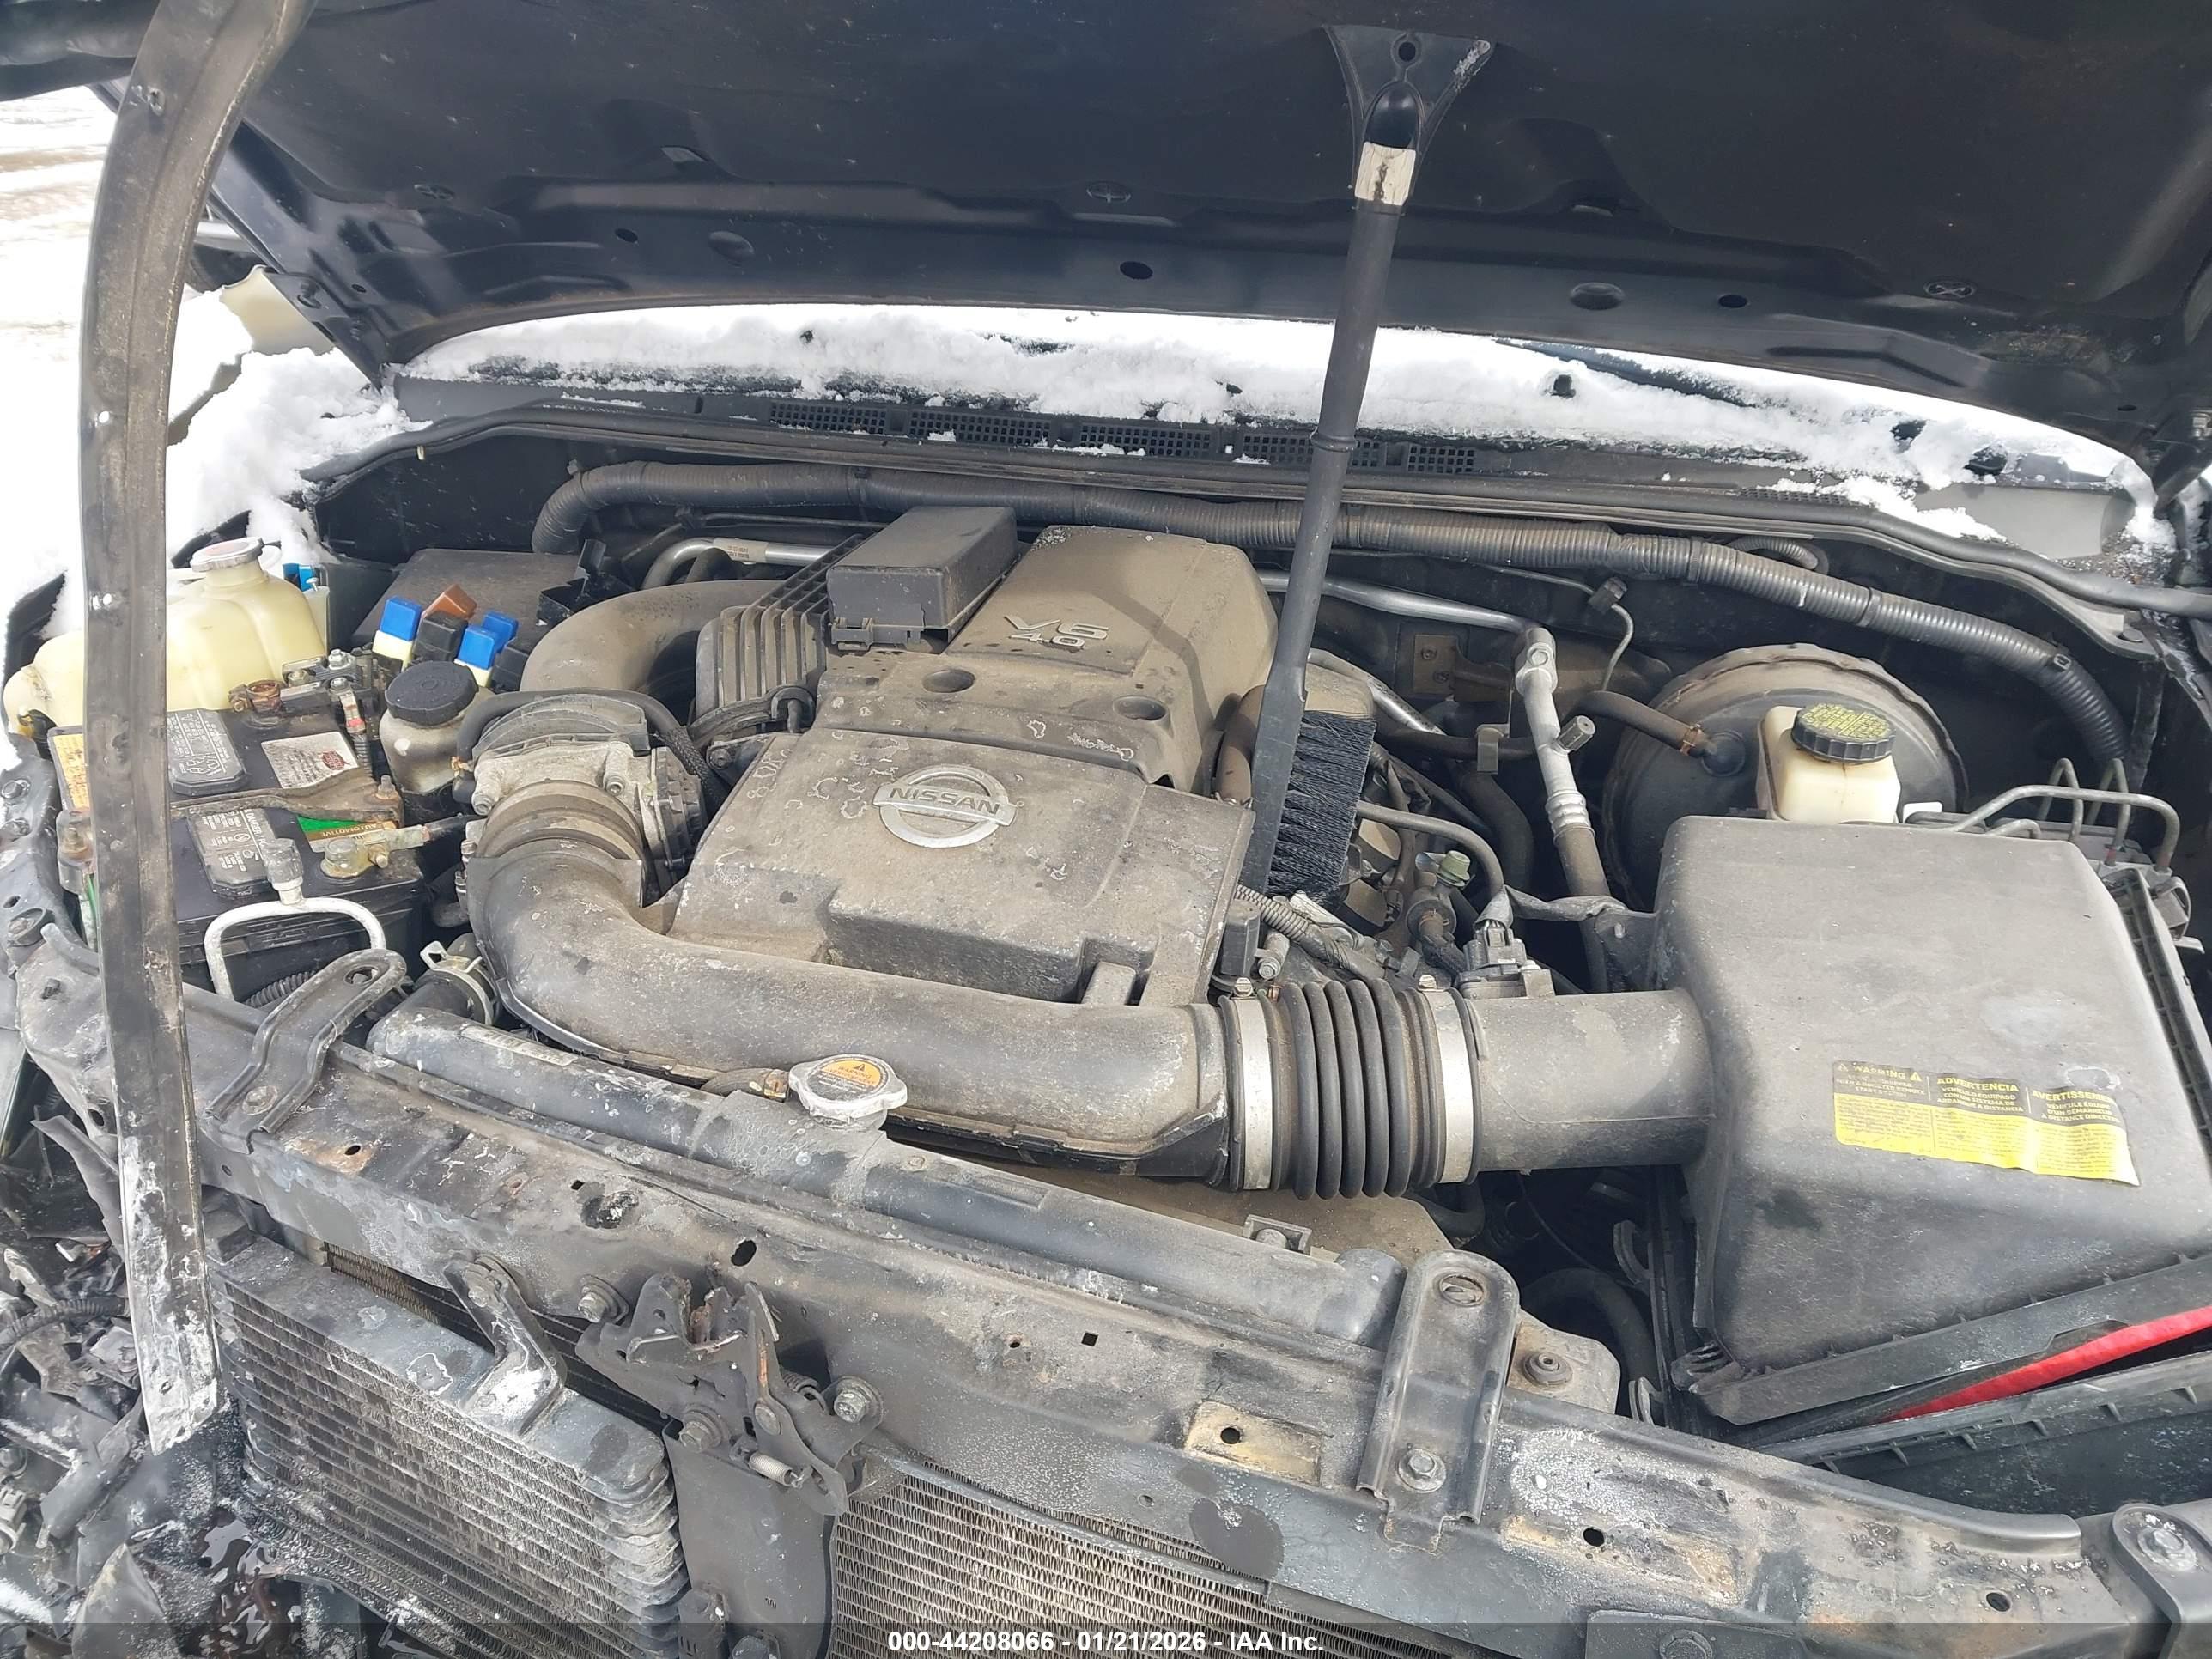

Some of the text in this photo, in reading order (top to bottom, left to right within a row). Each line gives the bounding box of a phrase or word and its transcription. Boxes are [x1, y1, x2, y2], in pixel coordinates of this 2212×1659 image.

[1003, 615, 1109, 641] V6
[890, 787, 1000, 815] NISSAN
[1937, 1077, 2020, 1092] ADVERTENCIA
